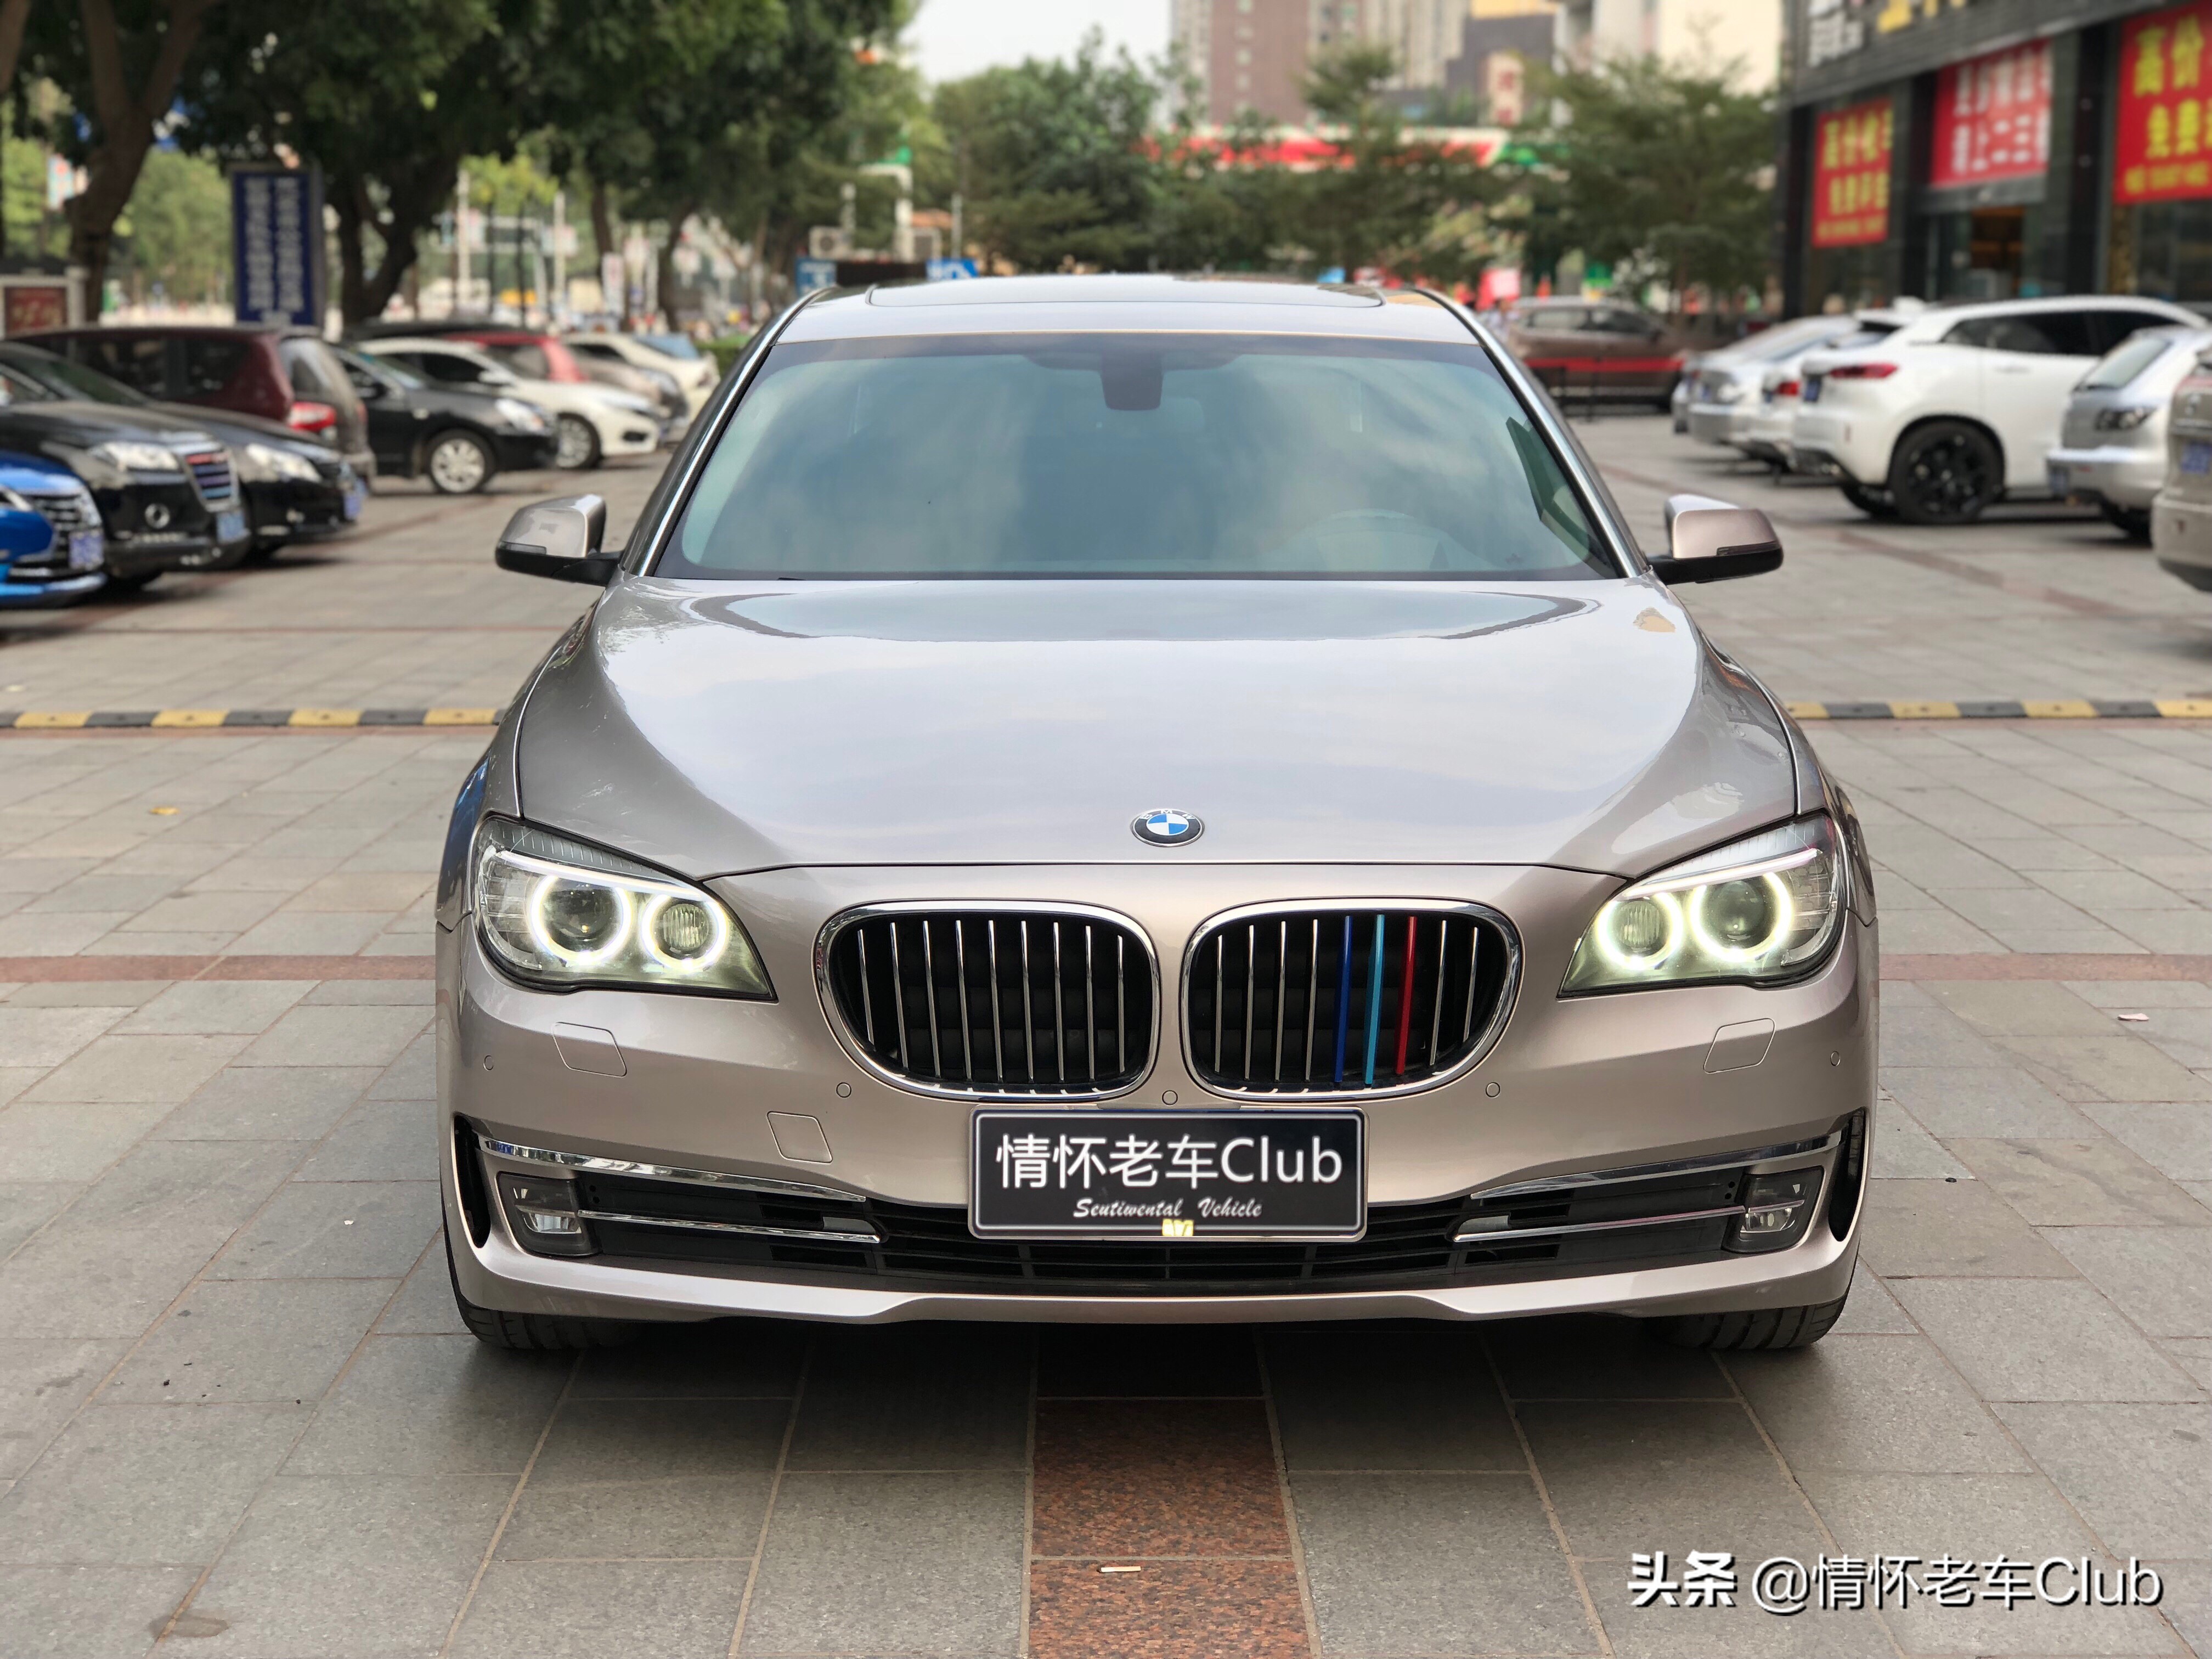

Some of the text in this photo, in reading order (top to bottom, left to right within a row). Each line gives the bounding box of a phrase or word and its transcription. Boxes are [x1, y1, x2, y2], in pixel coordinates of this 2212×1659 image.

[995, 1133, 1343, 1189] 情怀老车Club
[1198, 1197, 1262, 1218] Vehicle
